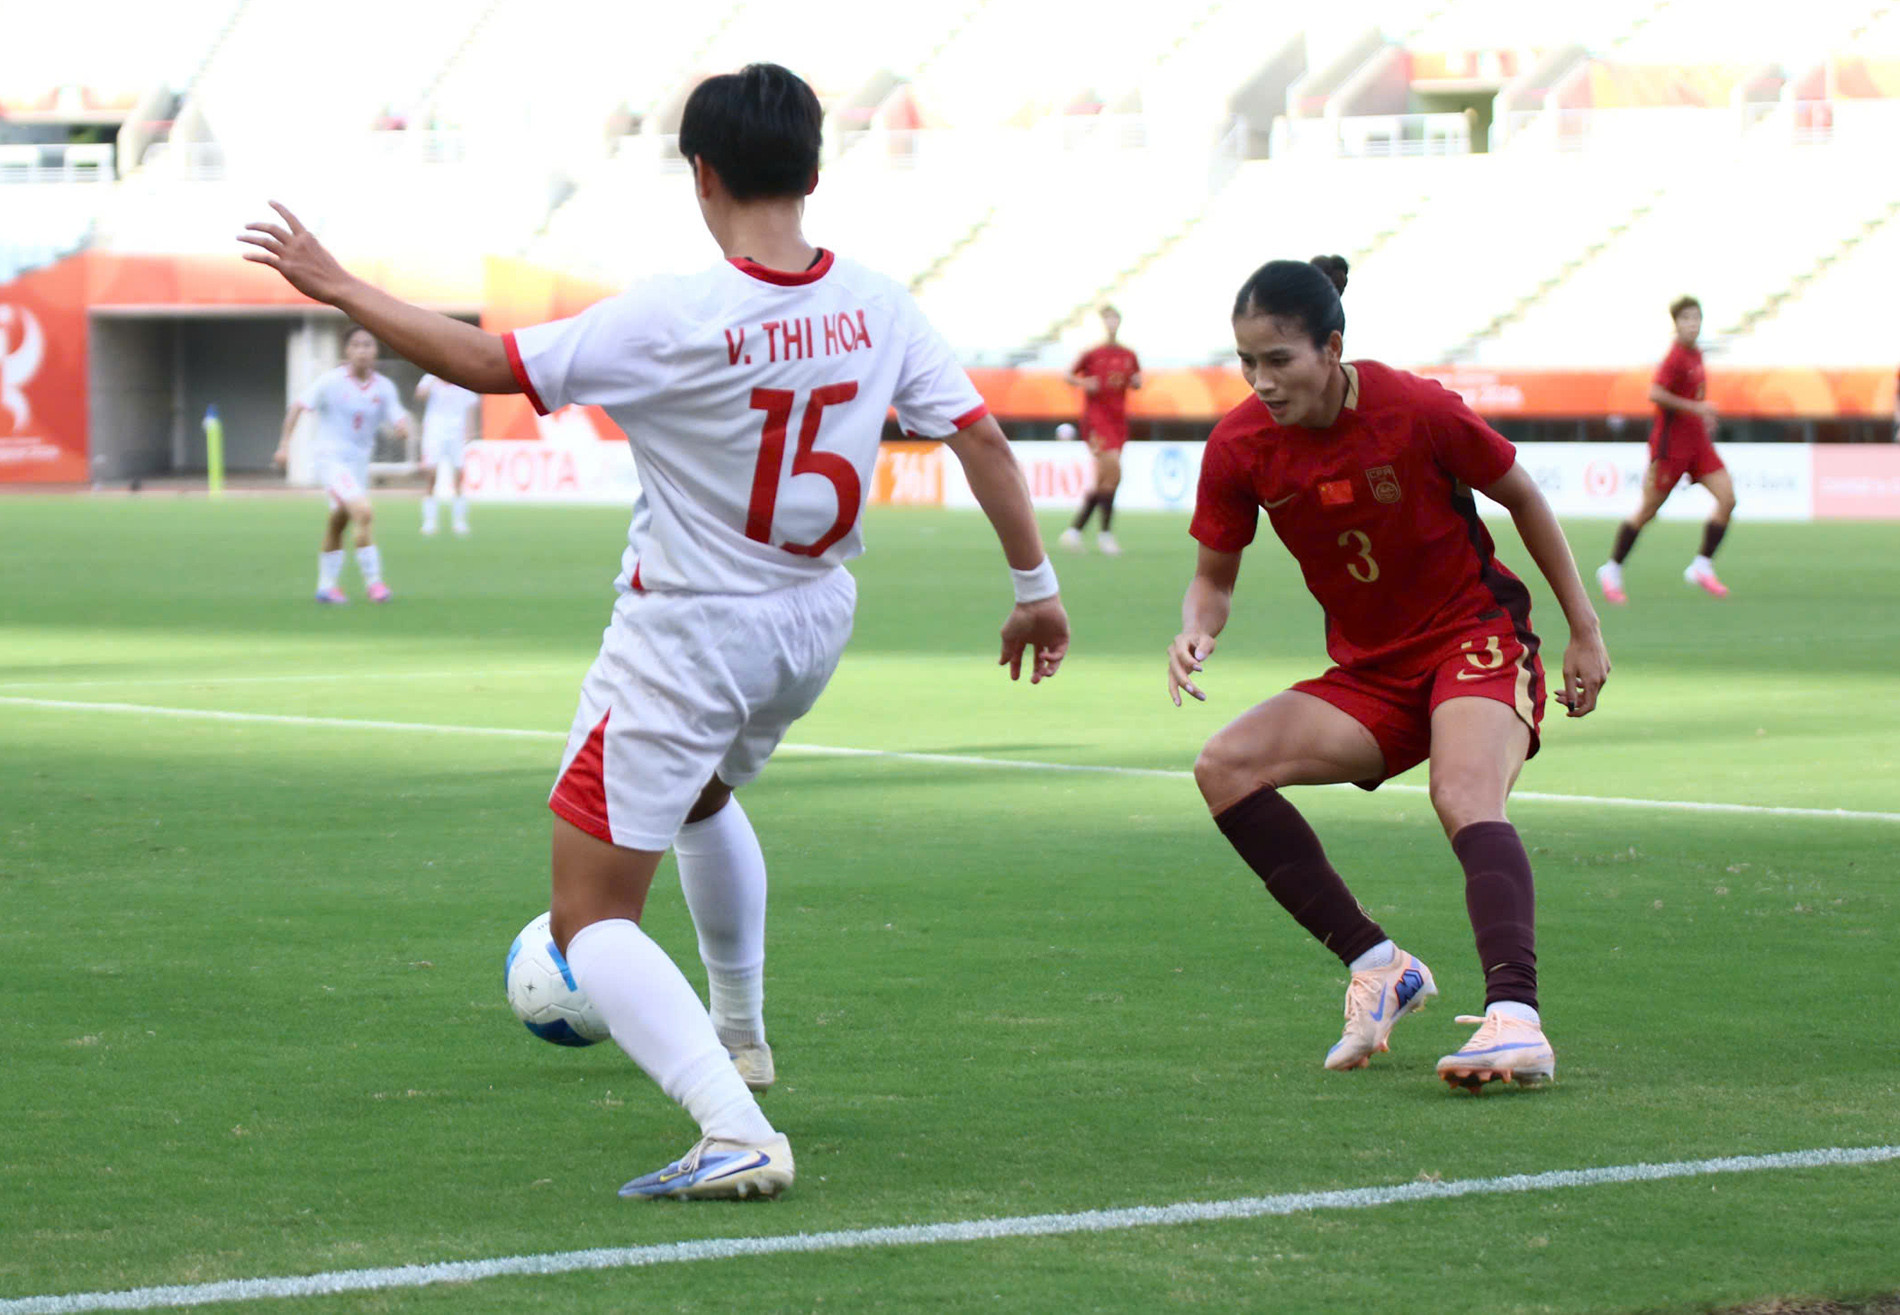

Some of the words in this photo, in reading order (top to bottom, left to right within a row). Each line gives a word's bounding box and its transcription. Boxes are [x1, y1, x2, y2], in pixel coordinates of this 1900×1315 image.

[724, 326, 752, 366] V.
[761, 316, 814, 363] THI
[823, 309, 873, 354] HOA
[464, 449, 584, 491] OYOTA
[745, 380, 861, 558] 15
[1337, 529, 1380, 583] 3
[1460, 635, 1504, 669] 3
